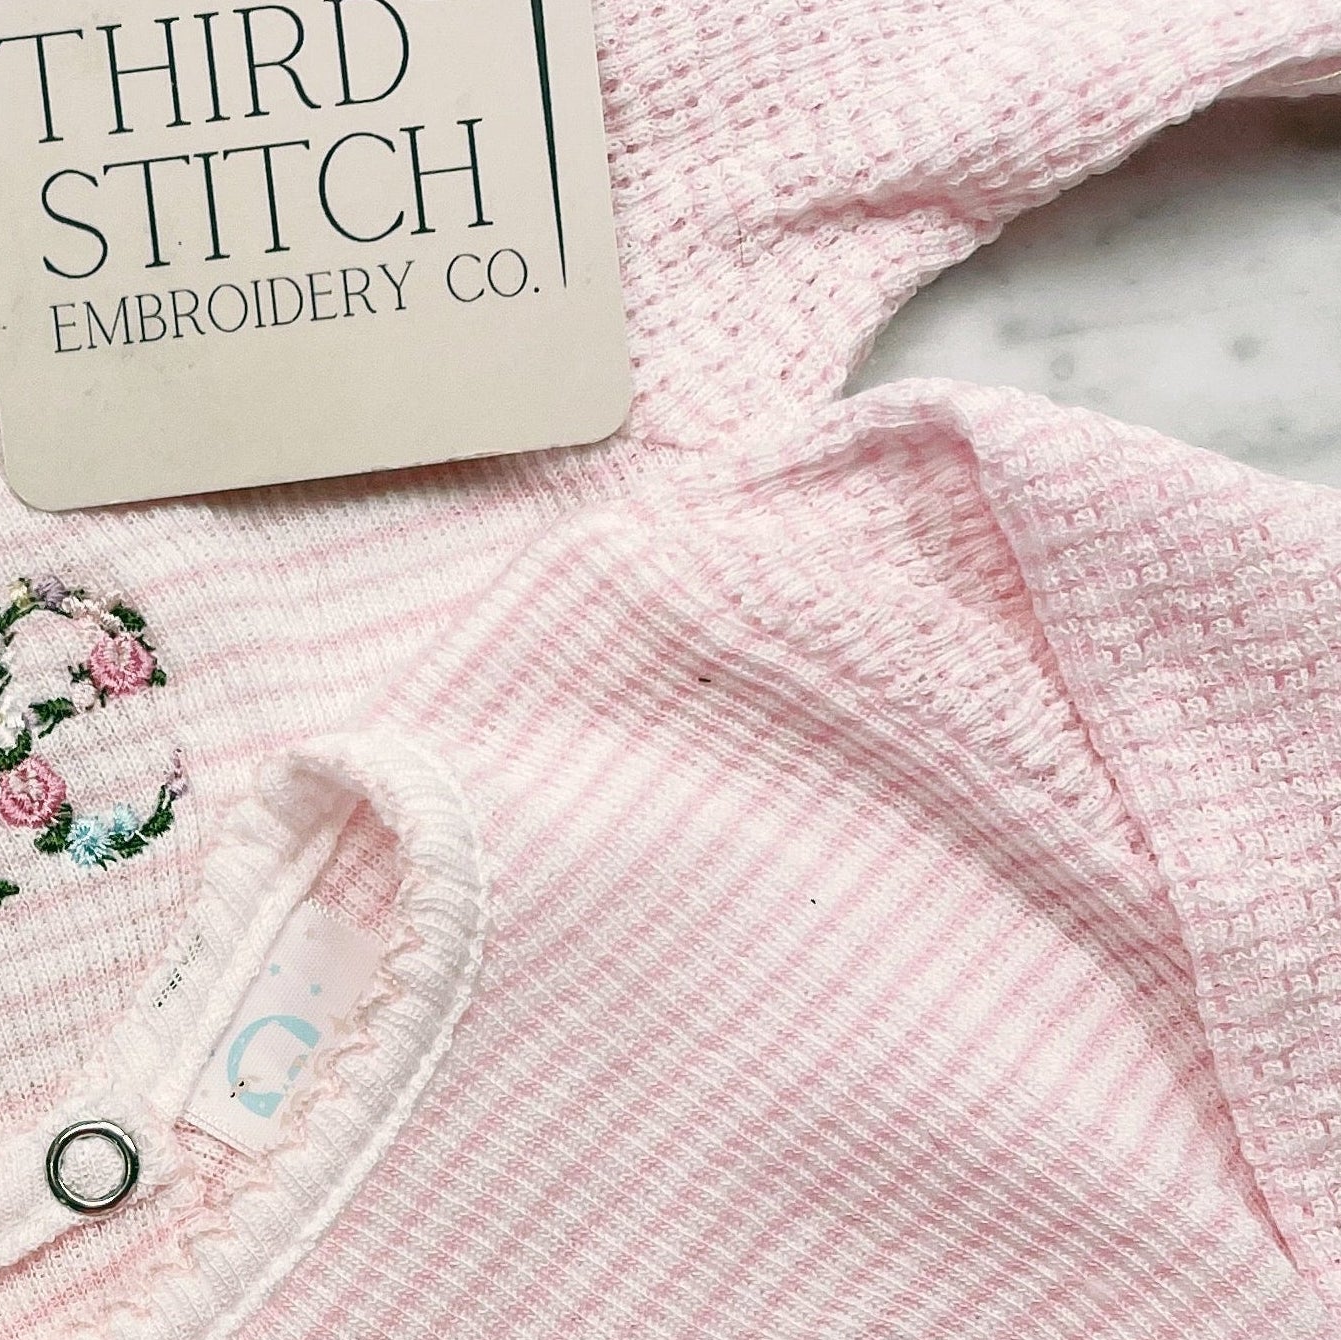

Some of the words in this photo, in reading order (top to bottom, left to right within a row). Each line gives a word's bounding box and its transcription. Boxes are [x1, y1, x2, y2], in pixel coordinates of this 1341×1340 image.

[41, 118, 494, 279] STITCH
[49, 260, 416, 354] EMBROIDERY
[446, 248, 541, 303] CO.
